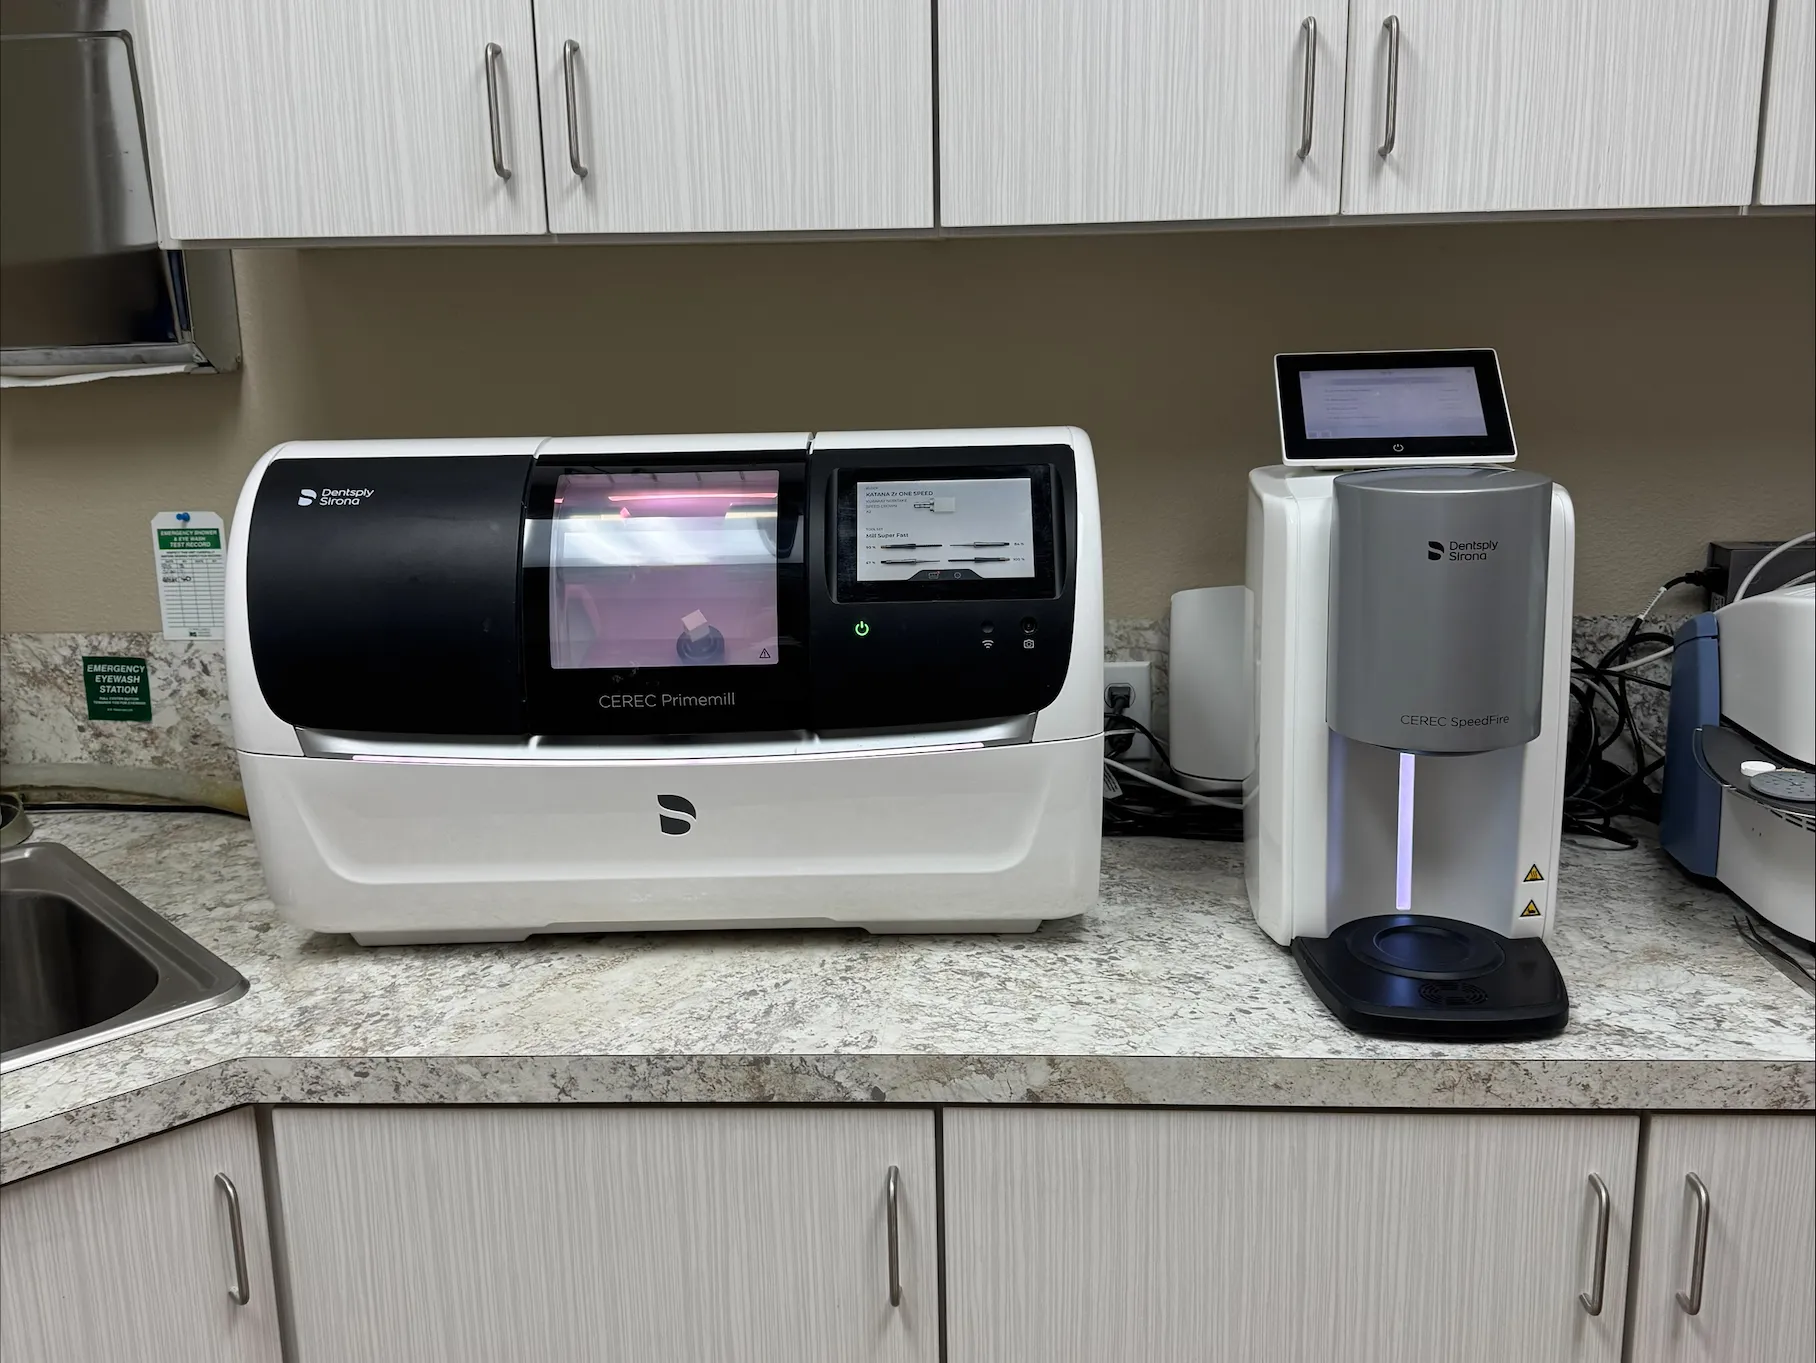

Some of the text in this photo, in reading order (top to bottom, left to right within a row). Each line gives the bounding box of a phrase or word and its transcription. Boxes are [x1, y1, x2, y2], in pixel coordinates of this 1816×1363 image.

[321, 488, 375, 498] Dentsply
[319, 496, 360, 506] Sirona
[1449, 540, 1499, 551] Dentsply
[1449, 551, 1487, 561] Sirona
[87, 664, 145, 673] EMERGENCY
[95, 674, 141, 684] EYEWASH
[99, 685, 139, 694] STATION
[599, 692, 736, 709] CEREC Primemill
[1400, 714, 1510, 729] CEREC SpeedFire
